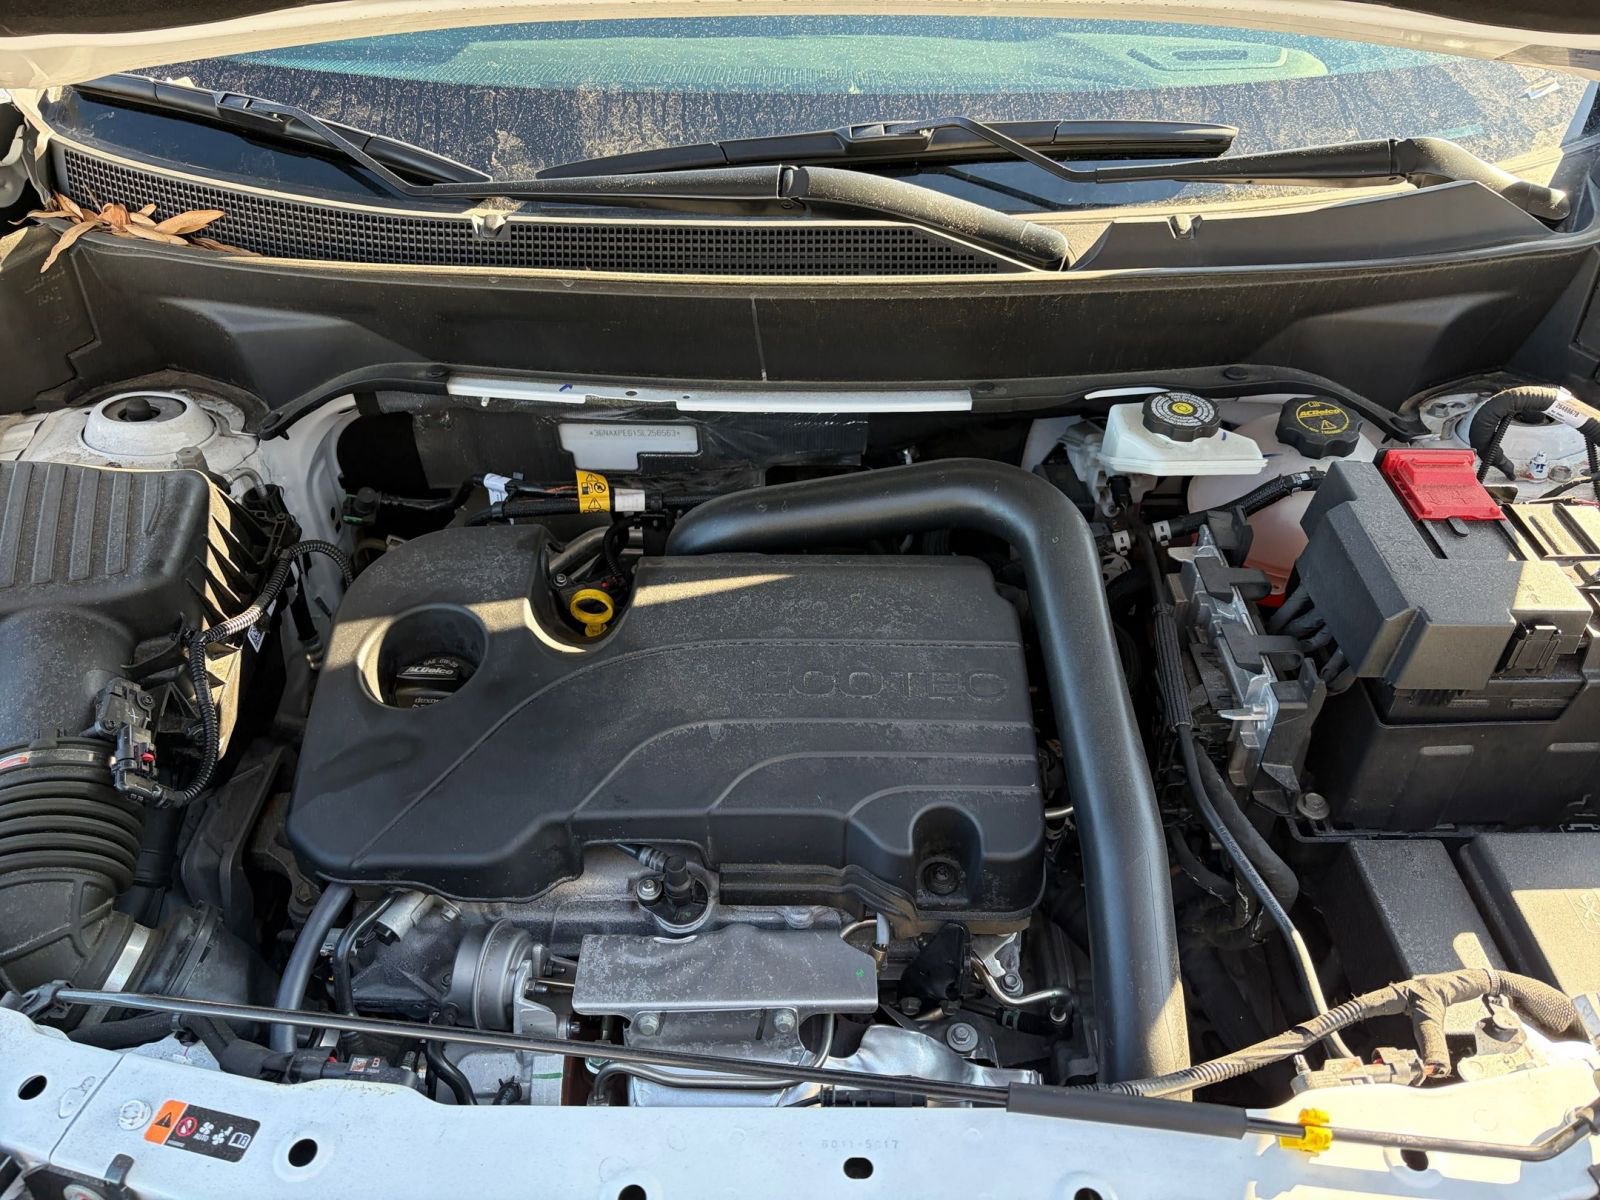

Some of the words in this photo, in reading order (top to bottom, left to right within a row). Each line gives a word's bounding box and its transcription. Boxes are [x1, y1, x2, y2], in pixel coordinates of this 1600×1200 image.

[404, 666, 455, 676] ACDelco
[754, 666, 1009, 702] ECOTEC
[371, 1057, 381, 1068] B
[192, 1132, 210, 1142] AUTO
